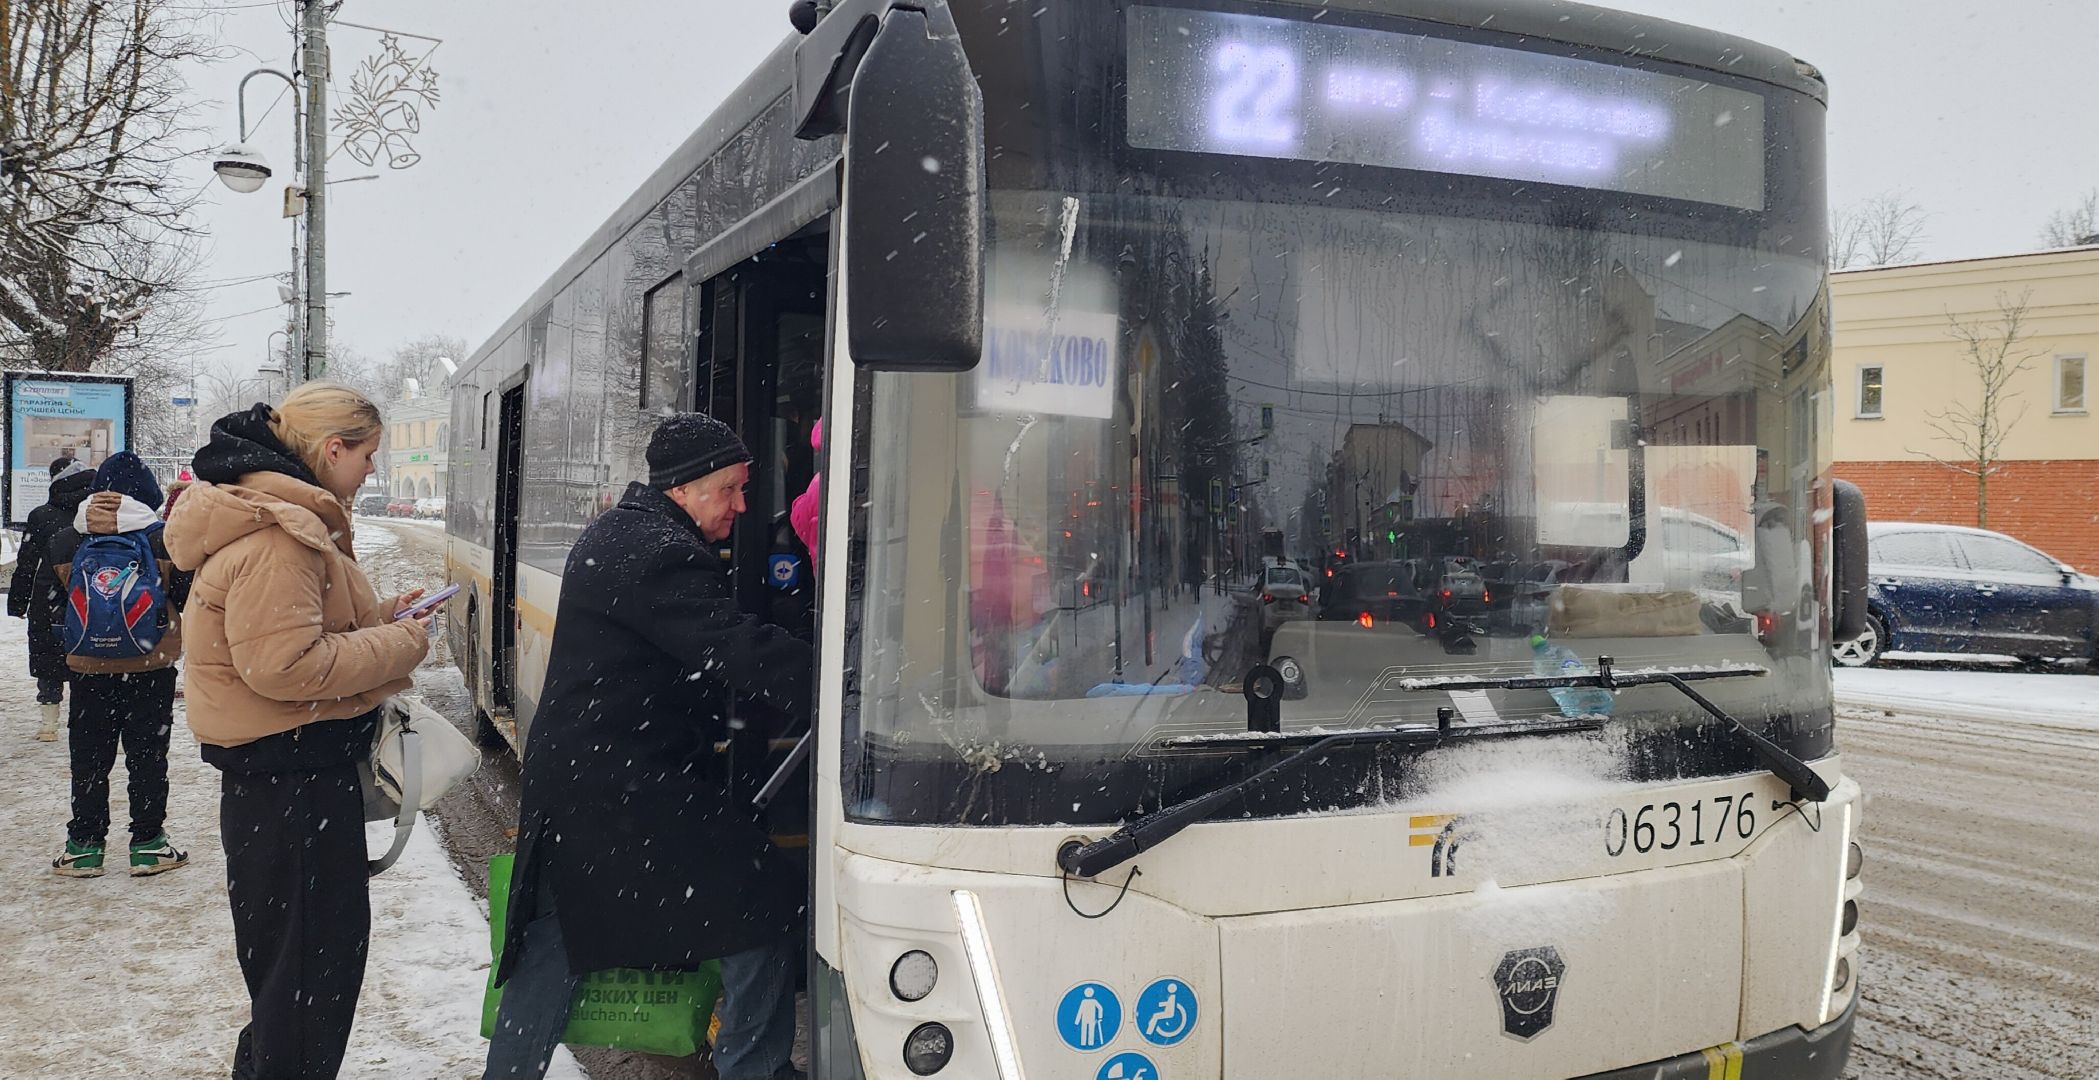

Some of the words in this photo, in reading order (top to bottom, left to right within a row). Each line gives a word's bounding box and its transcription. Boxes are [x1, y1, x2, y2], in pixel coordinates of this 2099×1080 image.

[1212, 43, 1296, 142] 22
[1604, 792, 1755, 857] 063176
[579, 989, 638, 1004] ИЗКИХ
[643, 990, 678, 1007] ЦЕН
